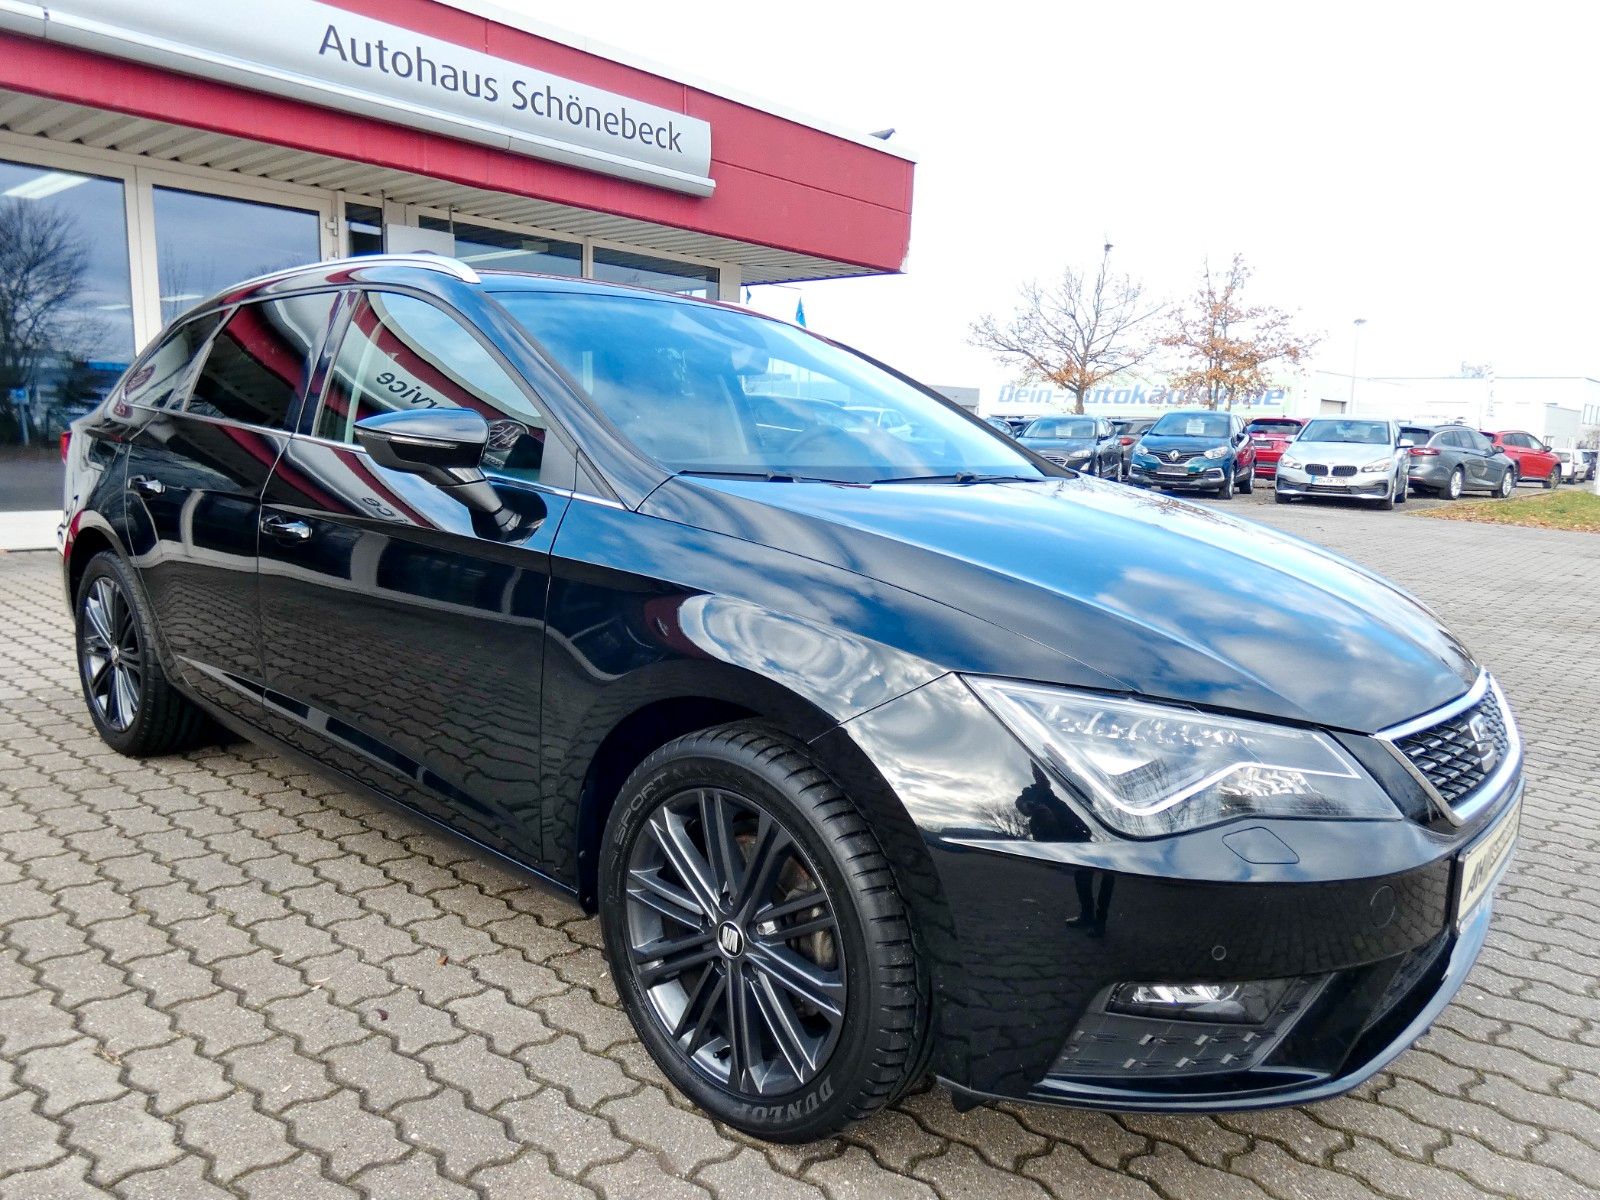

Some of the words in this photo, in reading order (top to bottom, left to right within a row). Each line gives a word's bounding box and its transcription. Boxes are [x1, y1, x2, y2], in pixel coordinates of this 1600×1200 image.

[318, 24, 499, 102] Autohaus
[511, 80, 683, 153] Schönebeck
[614, 771, 668, 846] SPORT
[734, 1075, 834, 1123] DUNLOP
